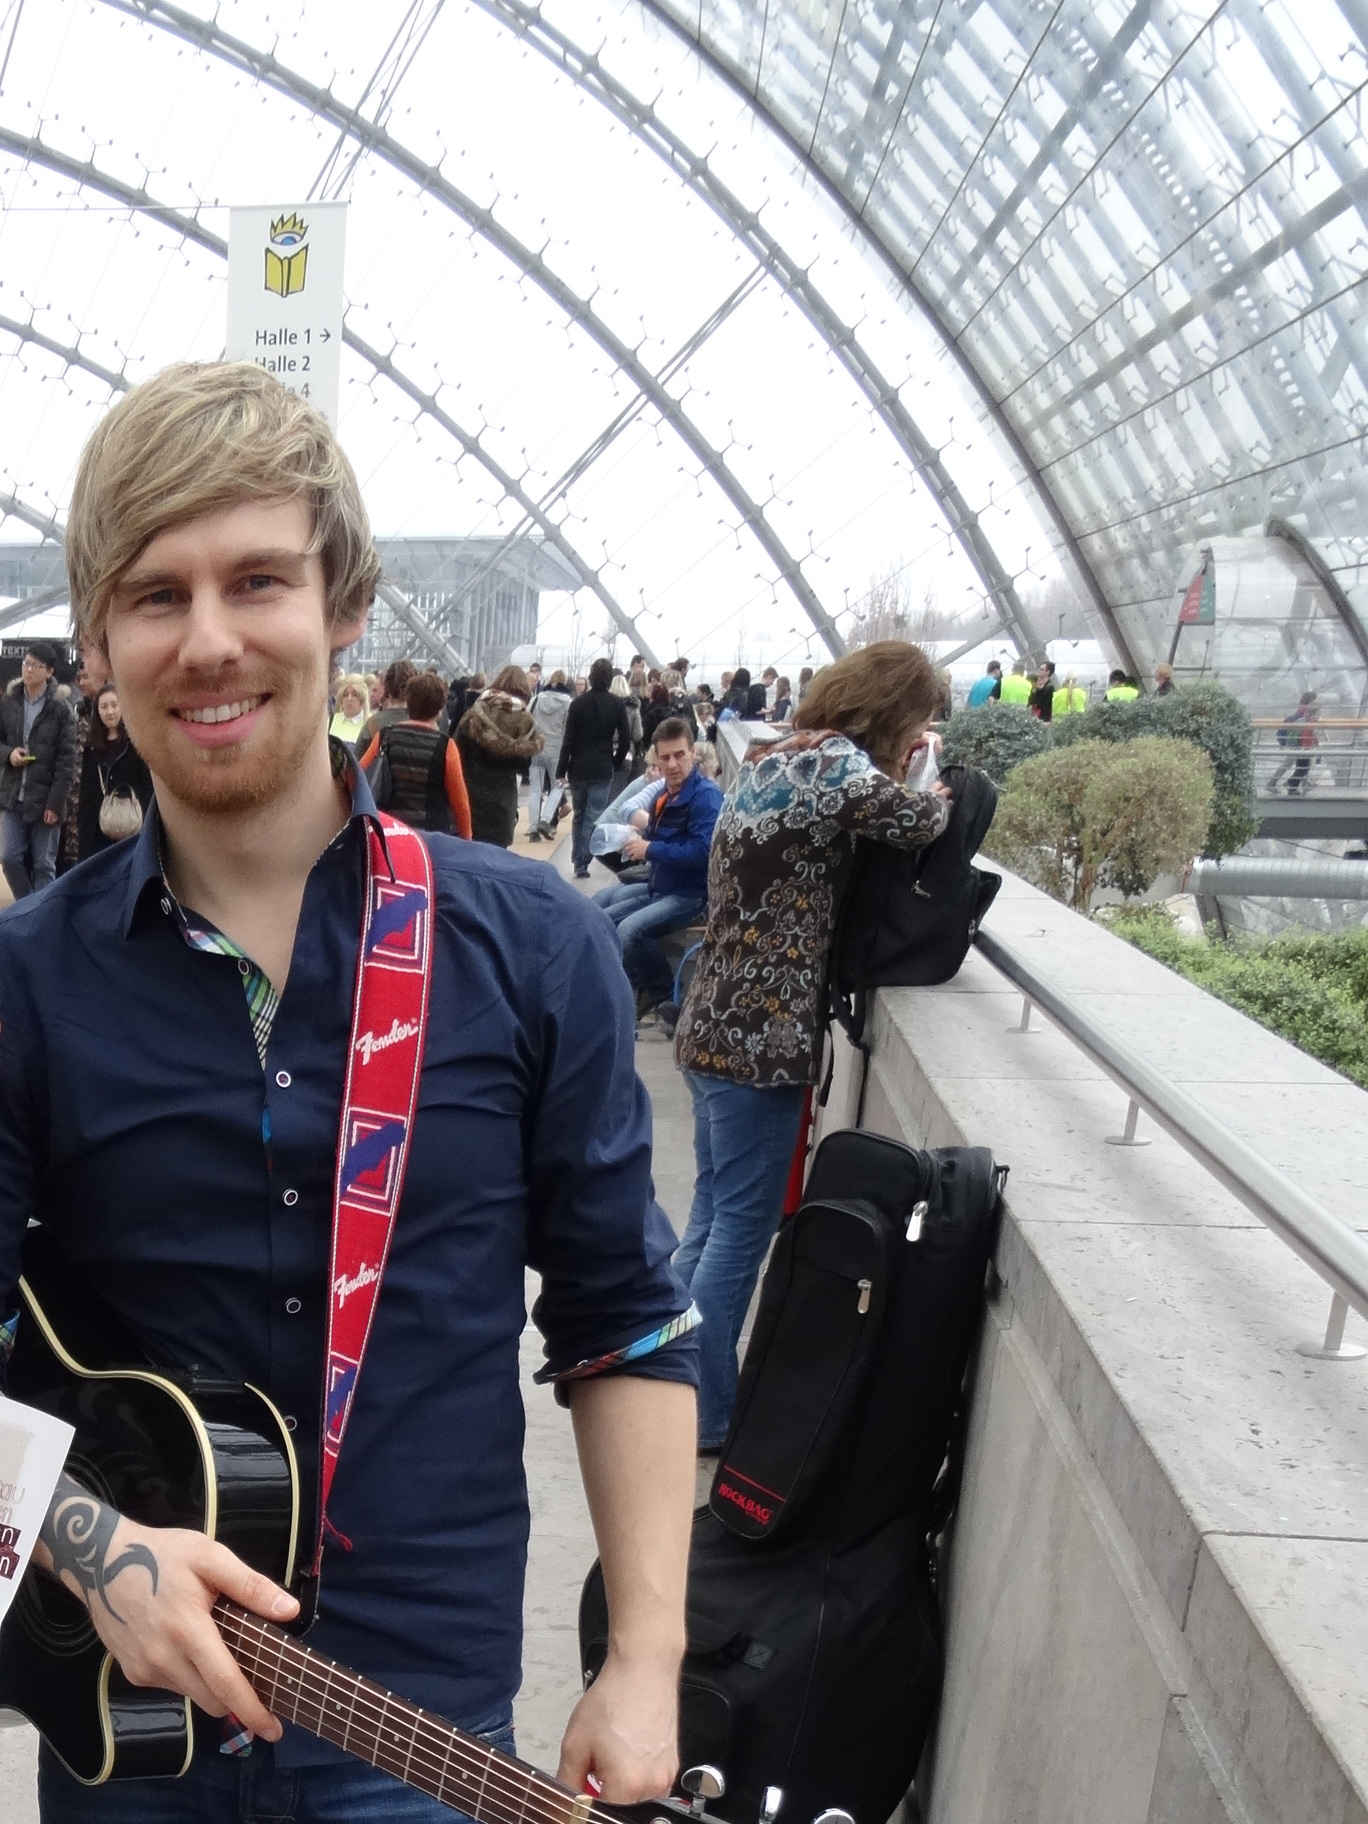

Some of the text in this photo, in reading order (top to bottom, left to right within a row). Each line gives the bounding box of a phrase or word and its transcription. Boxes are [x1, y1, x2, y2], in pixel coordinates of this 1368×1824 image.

[255, 328, 311, 345] Halle 1
[302, 356, 311, 371] 2
[301, 382, 311, 398] 4
[355, 1018, 418, 1066] Fender
[333, 1262, 379, 1309] Fender
[718, 1483, 770, 1521] ROCKBAG
